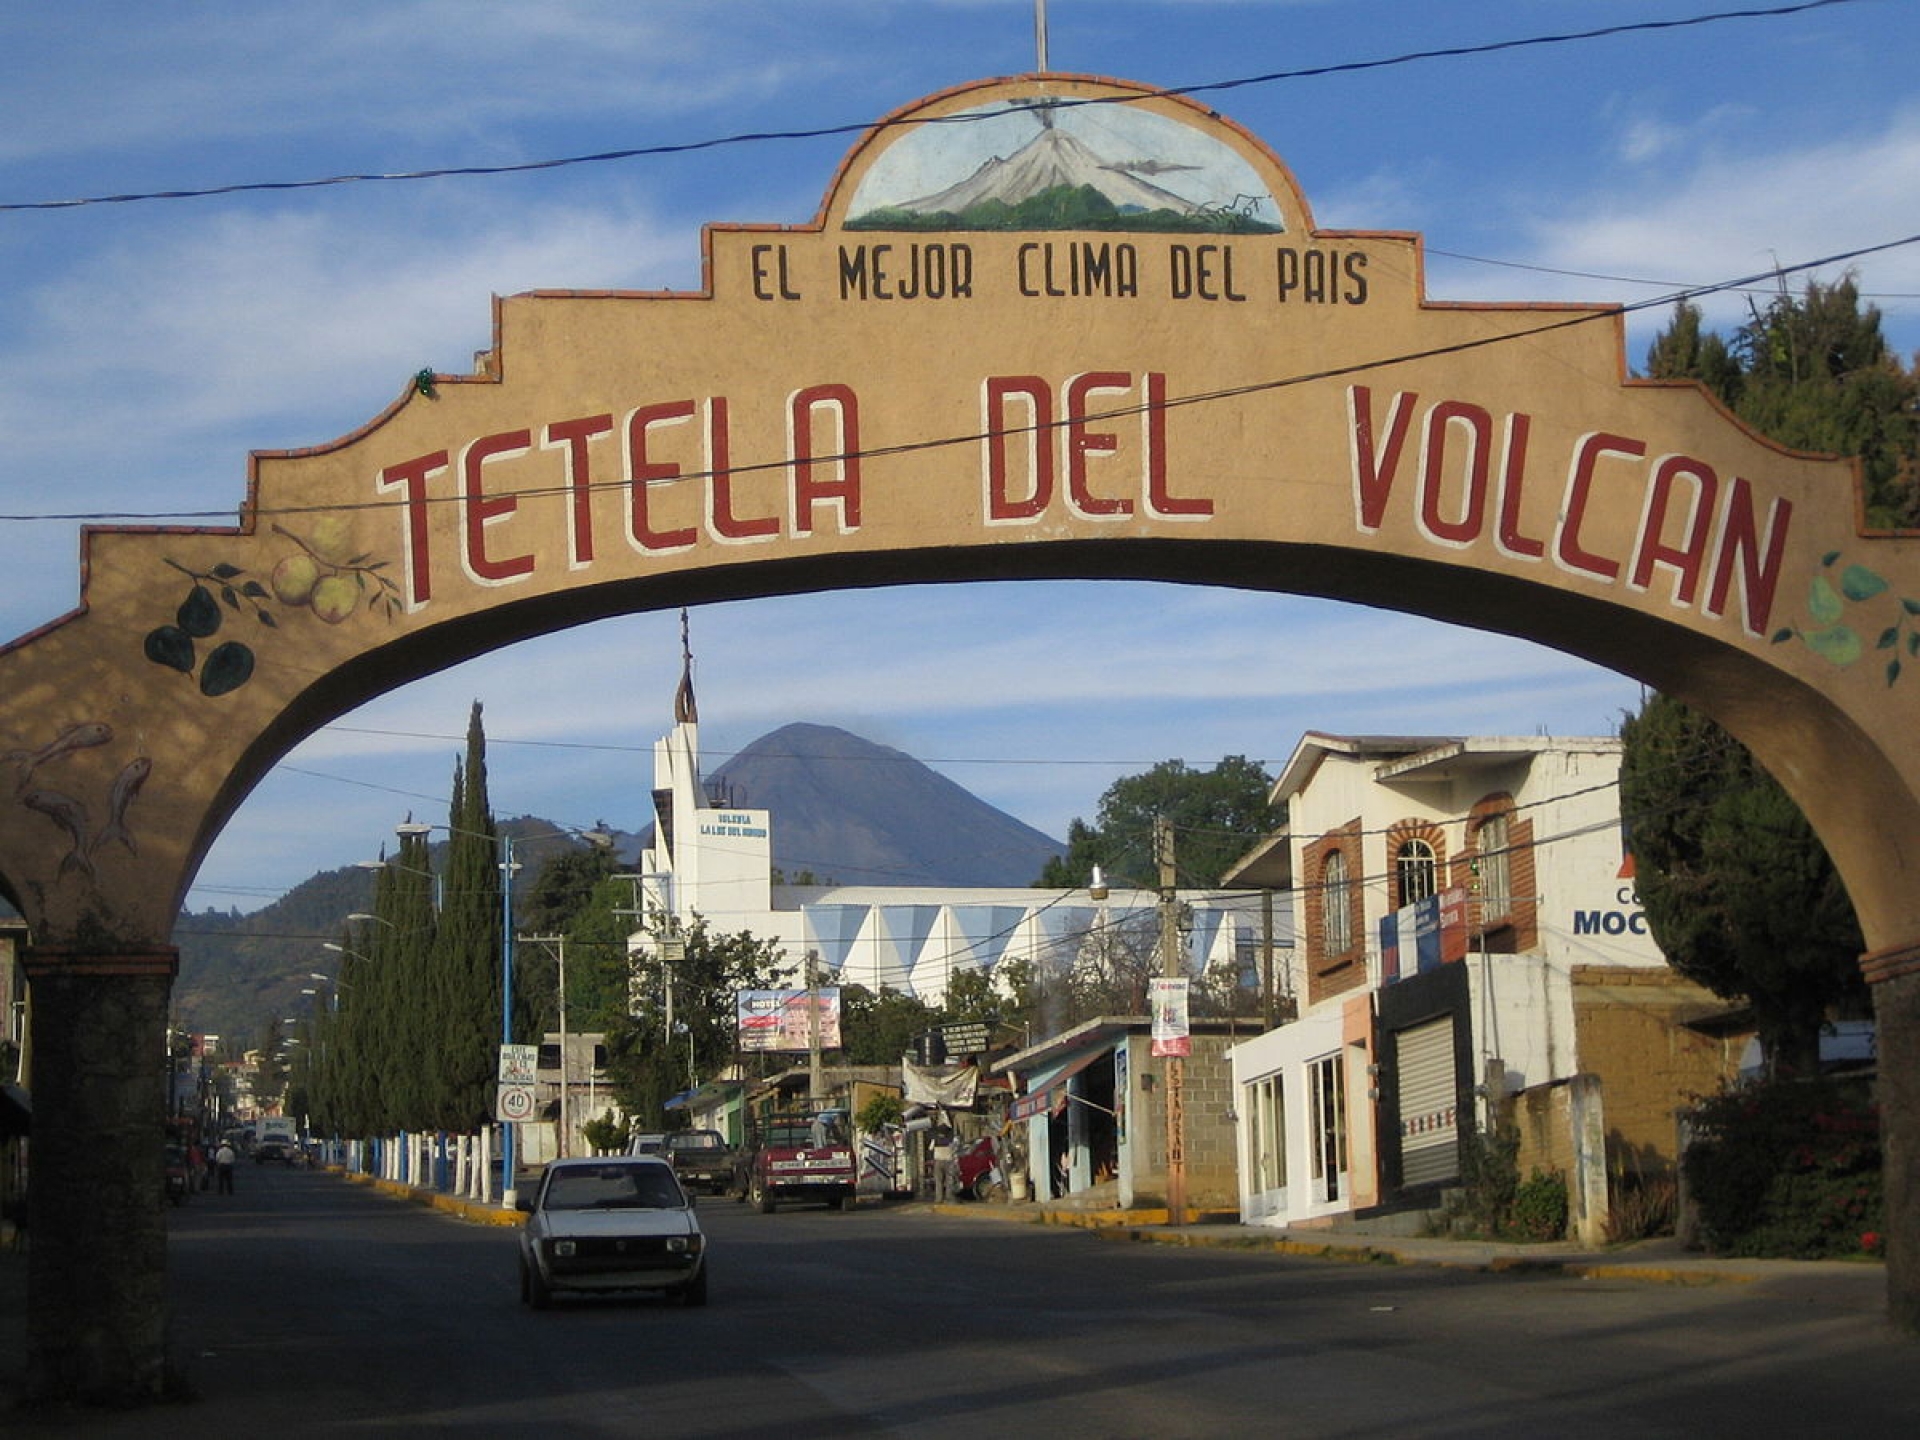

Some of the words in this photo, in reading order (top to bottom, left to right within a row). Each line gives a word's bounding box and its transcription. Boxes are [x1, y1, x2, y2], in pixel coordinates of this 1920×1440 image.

[752, 244, 801, 301] EL
[838, 243, 973, 301] MEJOR
[1018, 242, 1138, 298] CLIMA
[1170, 243, 1247, 302] DEL
[1278, 248, 1369, 305] PAIS
[376, 384, 862, 614] TETELA
[980, 371, 1214, 527] DEL
[1346, 385, 1793, 638] VOLCAN
[508, 1093, 524, 1108] 40
